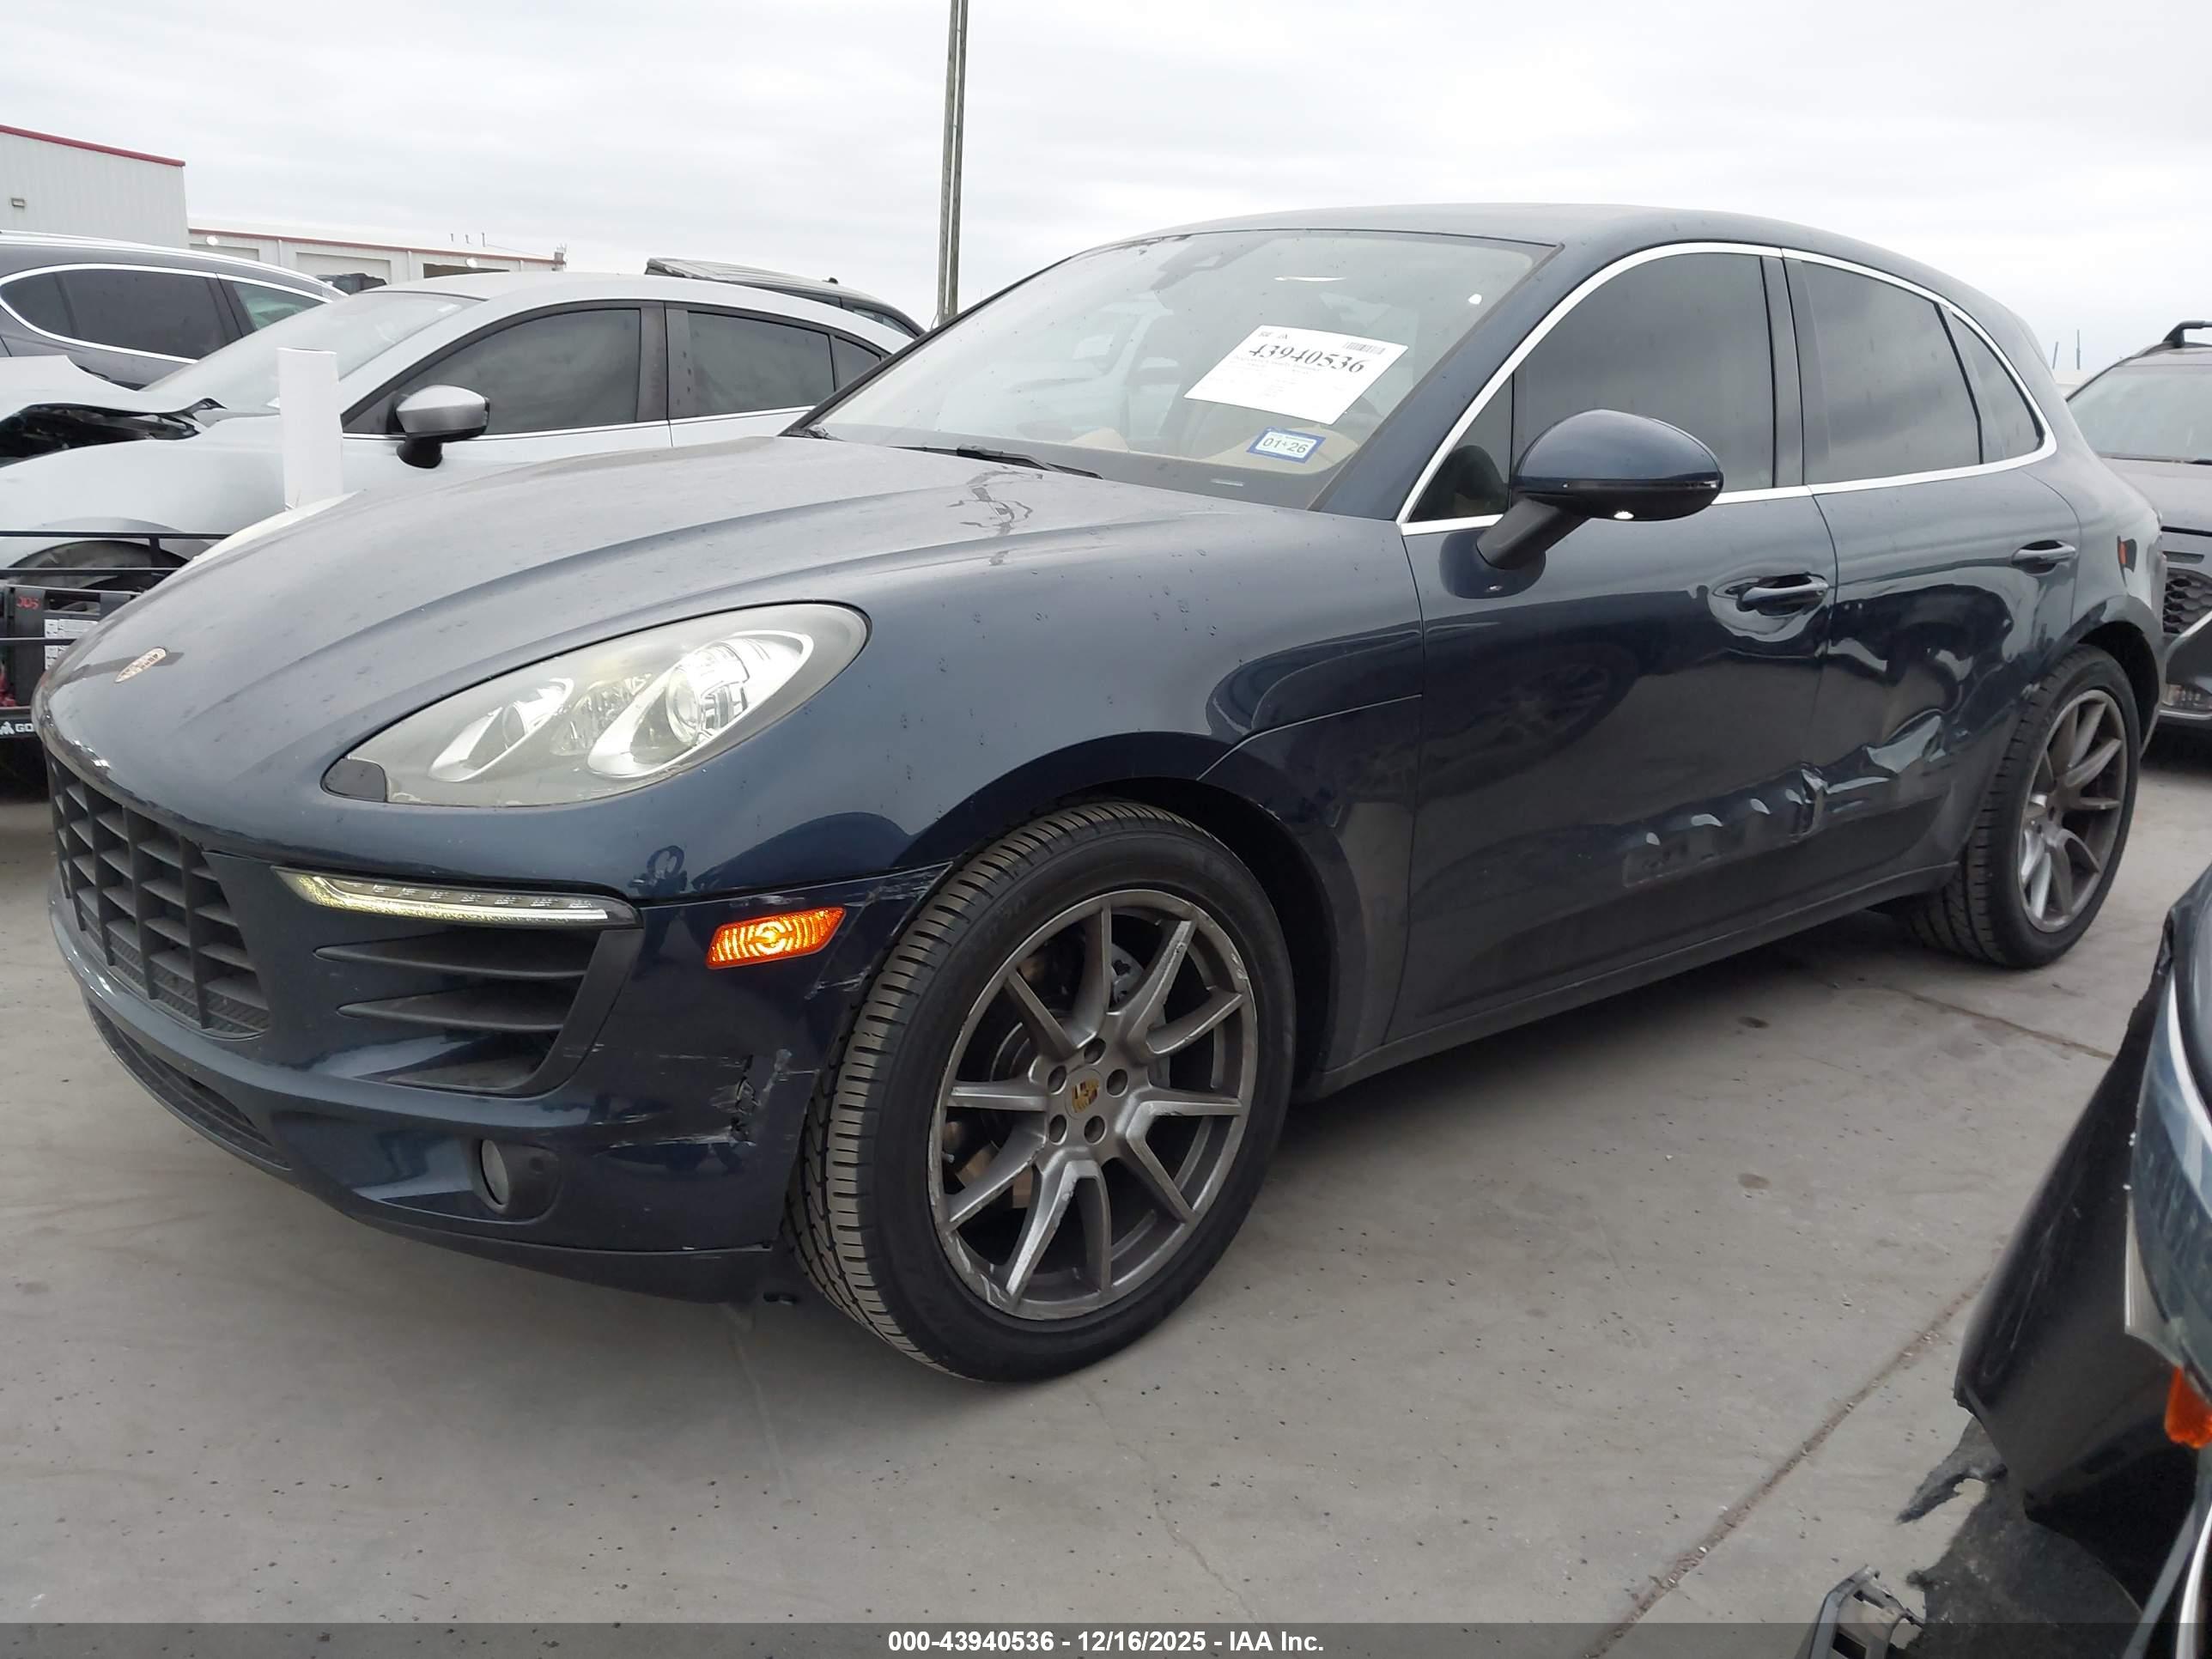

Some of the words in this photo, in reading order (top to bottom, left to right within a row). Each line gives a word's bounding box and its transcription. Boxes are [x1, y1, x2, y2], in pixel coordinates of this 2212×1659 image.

[1249, 343, 1370, 374] 43940536
[1262, 437, 1281, 449] 01
[1286, 441, 1310, 454] 26
